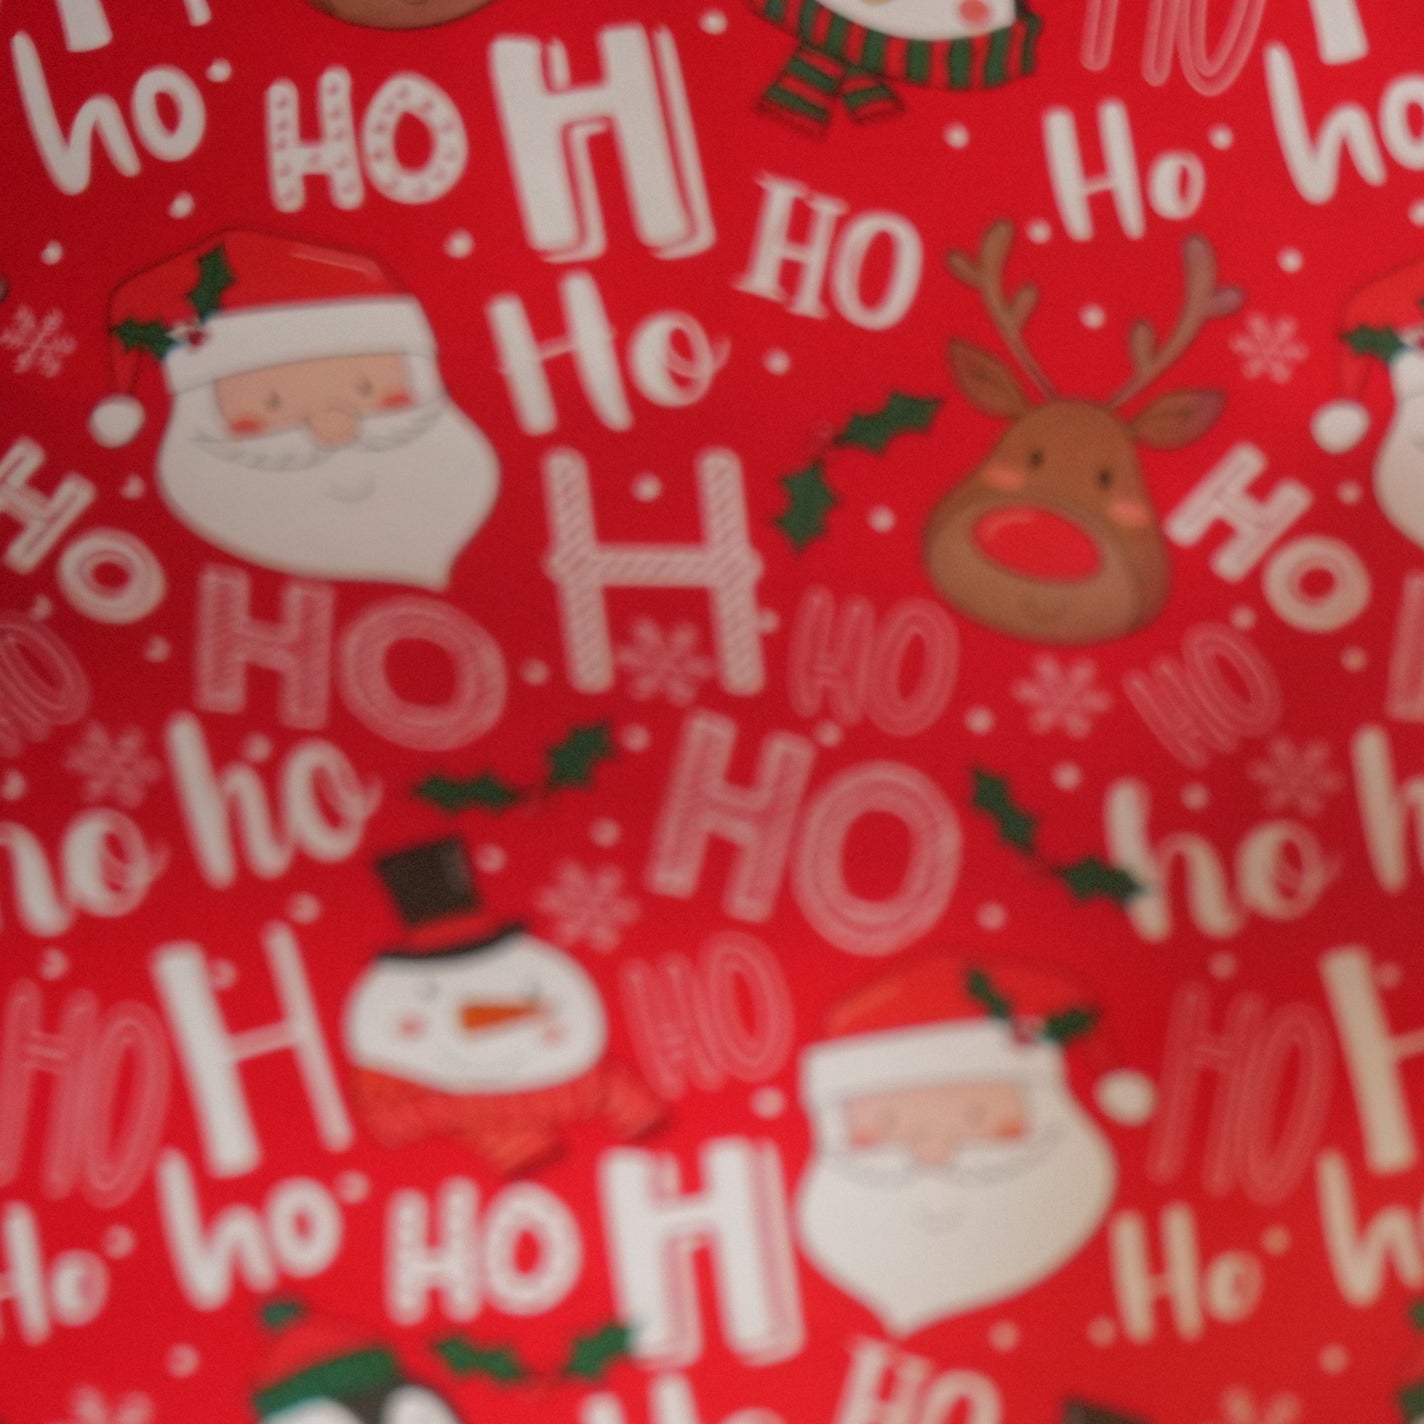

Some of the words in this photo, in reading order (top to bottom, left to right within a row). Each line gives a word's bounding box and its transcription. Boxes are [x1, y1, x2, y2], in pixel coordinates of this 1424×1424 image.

[12, 31, 206, 196] ho
[265, 66, 468, 213] HO
[488, 22, 716, 262] H
[1043, 98, 1205, 242] Ho
[732, 168, 923, 331] HO
[487, 270, 731, 436] Ho
[542, 446, 766, 695] H
[1163, 442, 1372, 633] HO
[193, 563, 507, 751] HO
[788, 583, 960, 738] HO
[1121, 622, 1284, 771] HO
[165, 710, 383, 888] ho
[645, 707, 963, 957] HO
[1105, 778, 1345, 943] ho
[148, 920, 356, 1178] H
[618, 931, 796, 1100] HO
[1145, 980, 1335, 1205] HO
[156, 1146, 344, 1313] ho
[383, 1174, 585, 1326] HO
[597, 1137, 806, 1371] H
[1108, 1202, 1264, 1345] Ho
